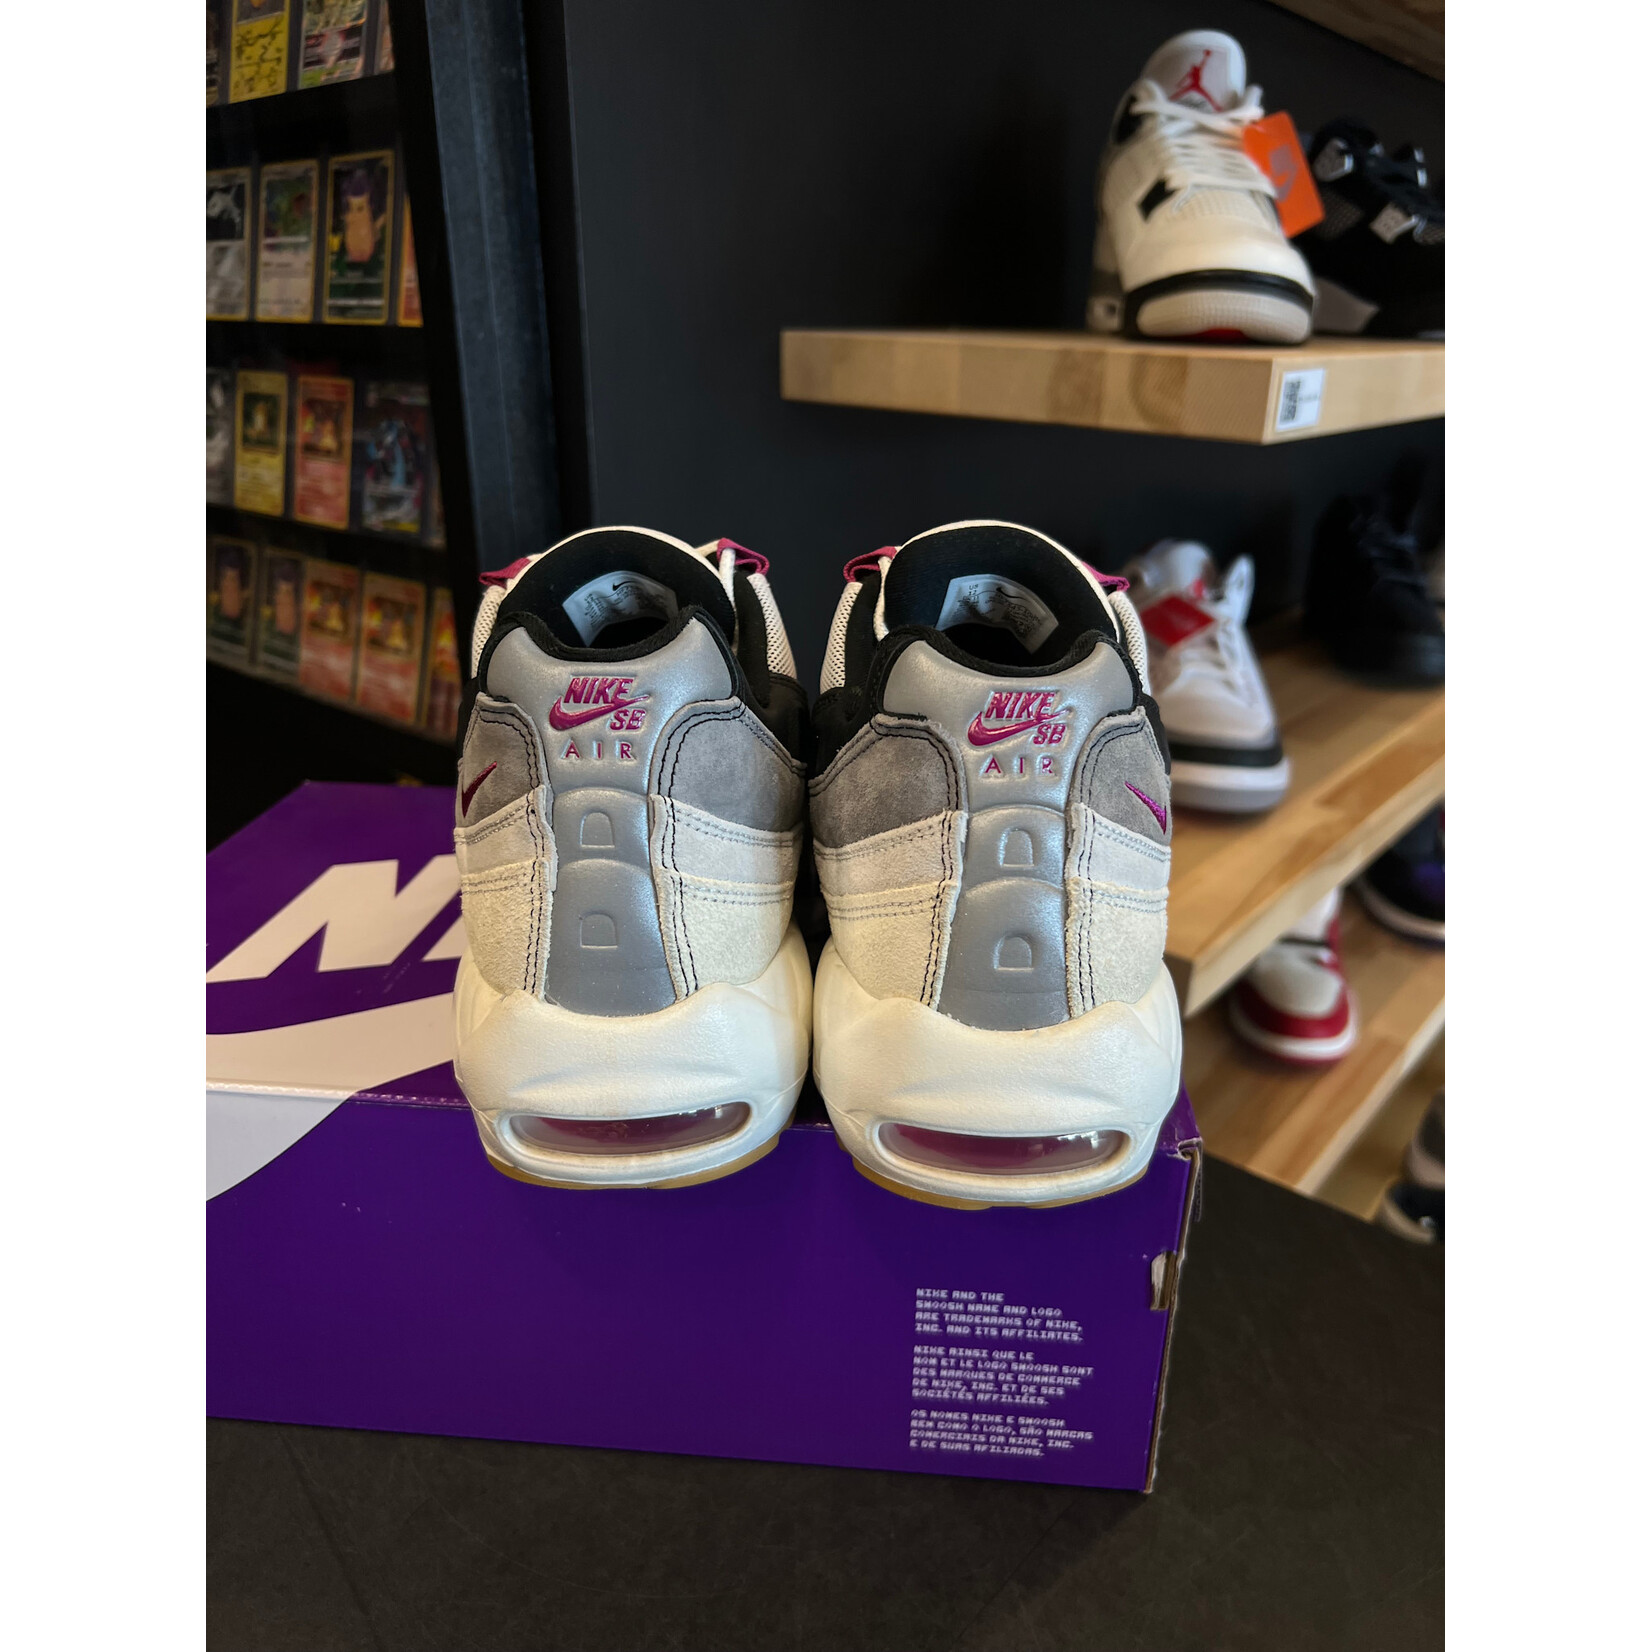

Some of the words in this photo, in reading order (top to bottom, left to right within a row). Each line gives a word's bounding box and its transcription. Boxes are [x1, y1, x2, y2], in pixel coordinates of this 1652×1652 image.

[563, 677, 634, 704] NIKE
[984, 691, 1056, 720] NIKE
[609, 708, 646, 731] SB
[1032, 722, 1066, 745] SB
[564, 741, 633, 759] AIR
[984, 757, 1054, 774] AIR
[916, 1287, 949, 1298] NIKE
[951, 1290, 977, 1300] AND
[980, 1291, 1005, 1302] THE
[967, 1302, 1000, 1313] NAME
[1003, 1304, 1028, 1316] AND
[1031, 1306, 1063, 1317] LOGO
[915, 1311, 940, 1321] ARE
[943, 1313, 1022, 1326] TRADEMARKS
[1025, 1317, 1043, 1327] OF
[1045, 1318, 1083, 1333] NIKE,
[914, 1322, 943, 1333] INC.
[945, 1324, 971, 1335] AND
[975, 1325, 998, 1336] ITS
[1001, 1327, 1084, 1342] AFFILIATES.
[913, 1344, 946, 1356] NIKE
[948, 1346, 989, 1358] AINSI
[991, 1348, 1017, 1360] QUE
[1019, 1351, 1035, 1361] LE
[940, 1357, 957, 1367] ET
[959, 1358, 974, 1368] LE
[977, 1359, 1008, 1370] LOGO
[912, 1366, 938, 1377] DES
[997, 1371, 1015, 1382] DE
[912, 1377, 929, 1388] DE
[1001, 1383, 1018, 1393] ET
[1020, 1384, 1037, 1394] DE
[971, 1412, 1004, 1423] NIKE
[1006, 1415, 1015, 1424] E
